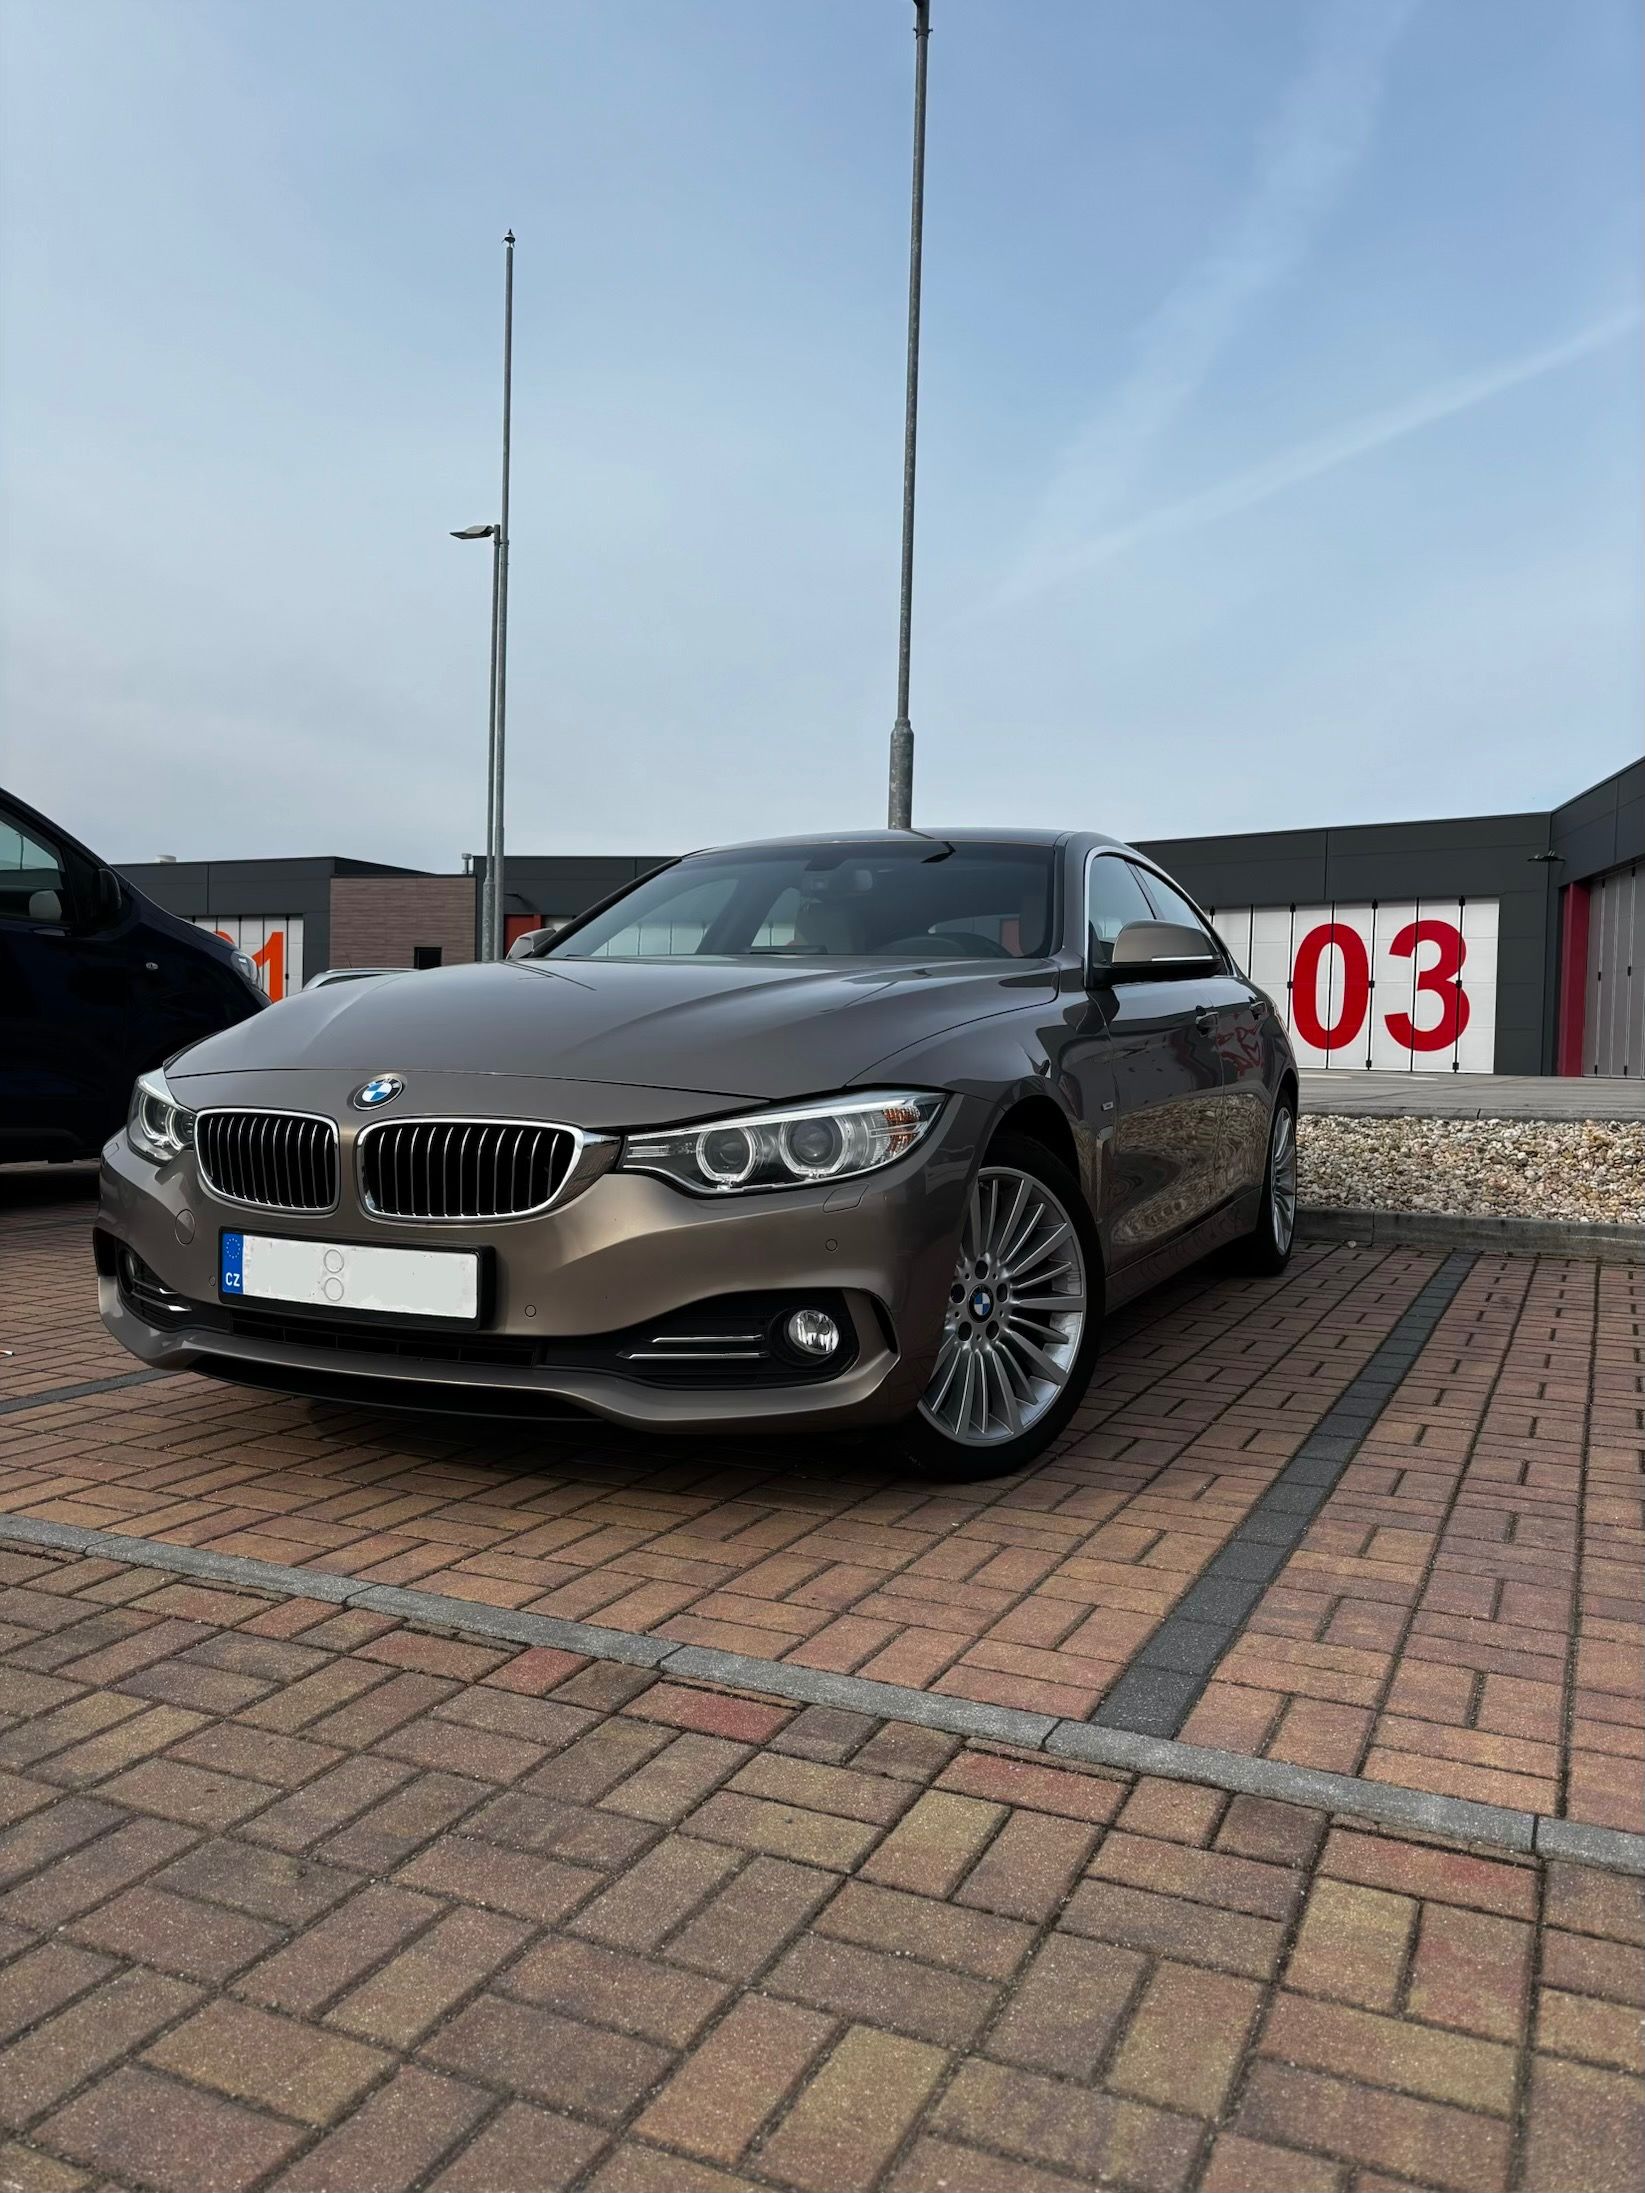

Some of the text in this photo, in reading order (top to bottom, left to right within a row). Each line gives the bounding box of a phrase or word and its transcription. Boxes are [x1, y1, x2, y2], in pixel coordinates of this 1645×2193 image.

[213, 929, 284, 1004] 1
[1292, 920, 1470, 1052] 03
[225, 1271, 241, 1287] CZ
